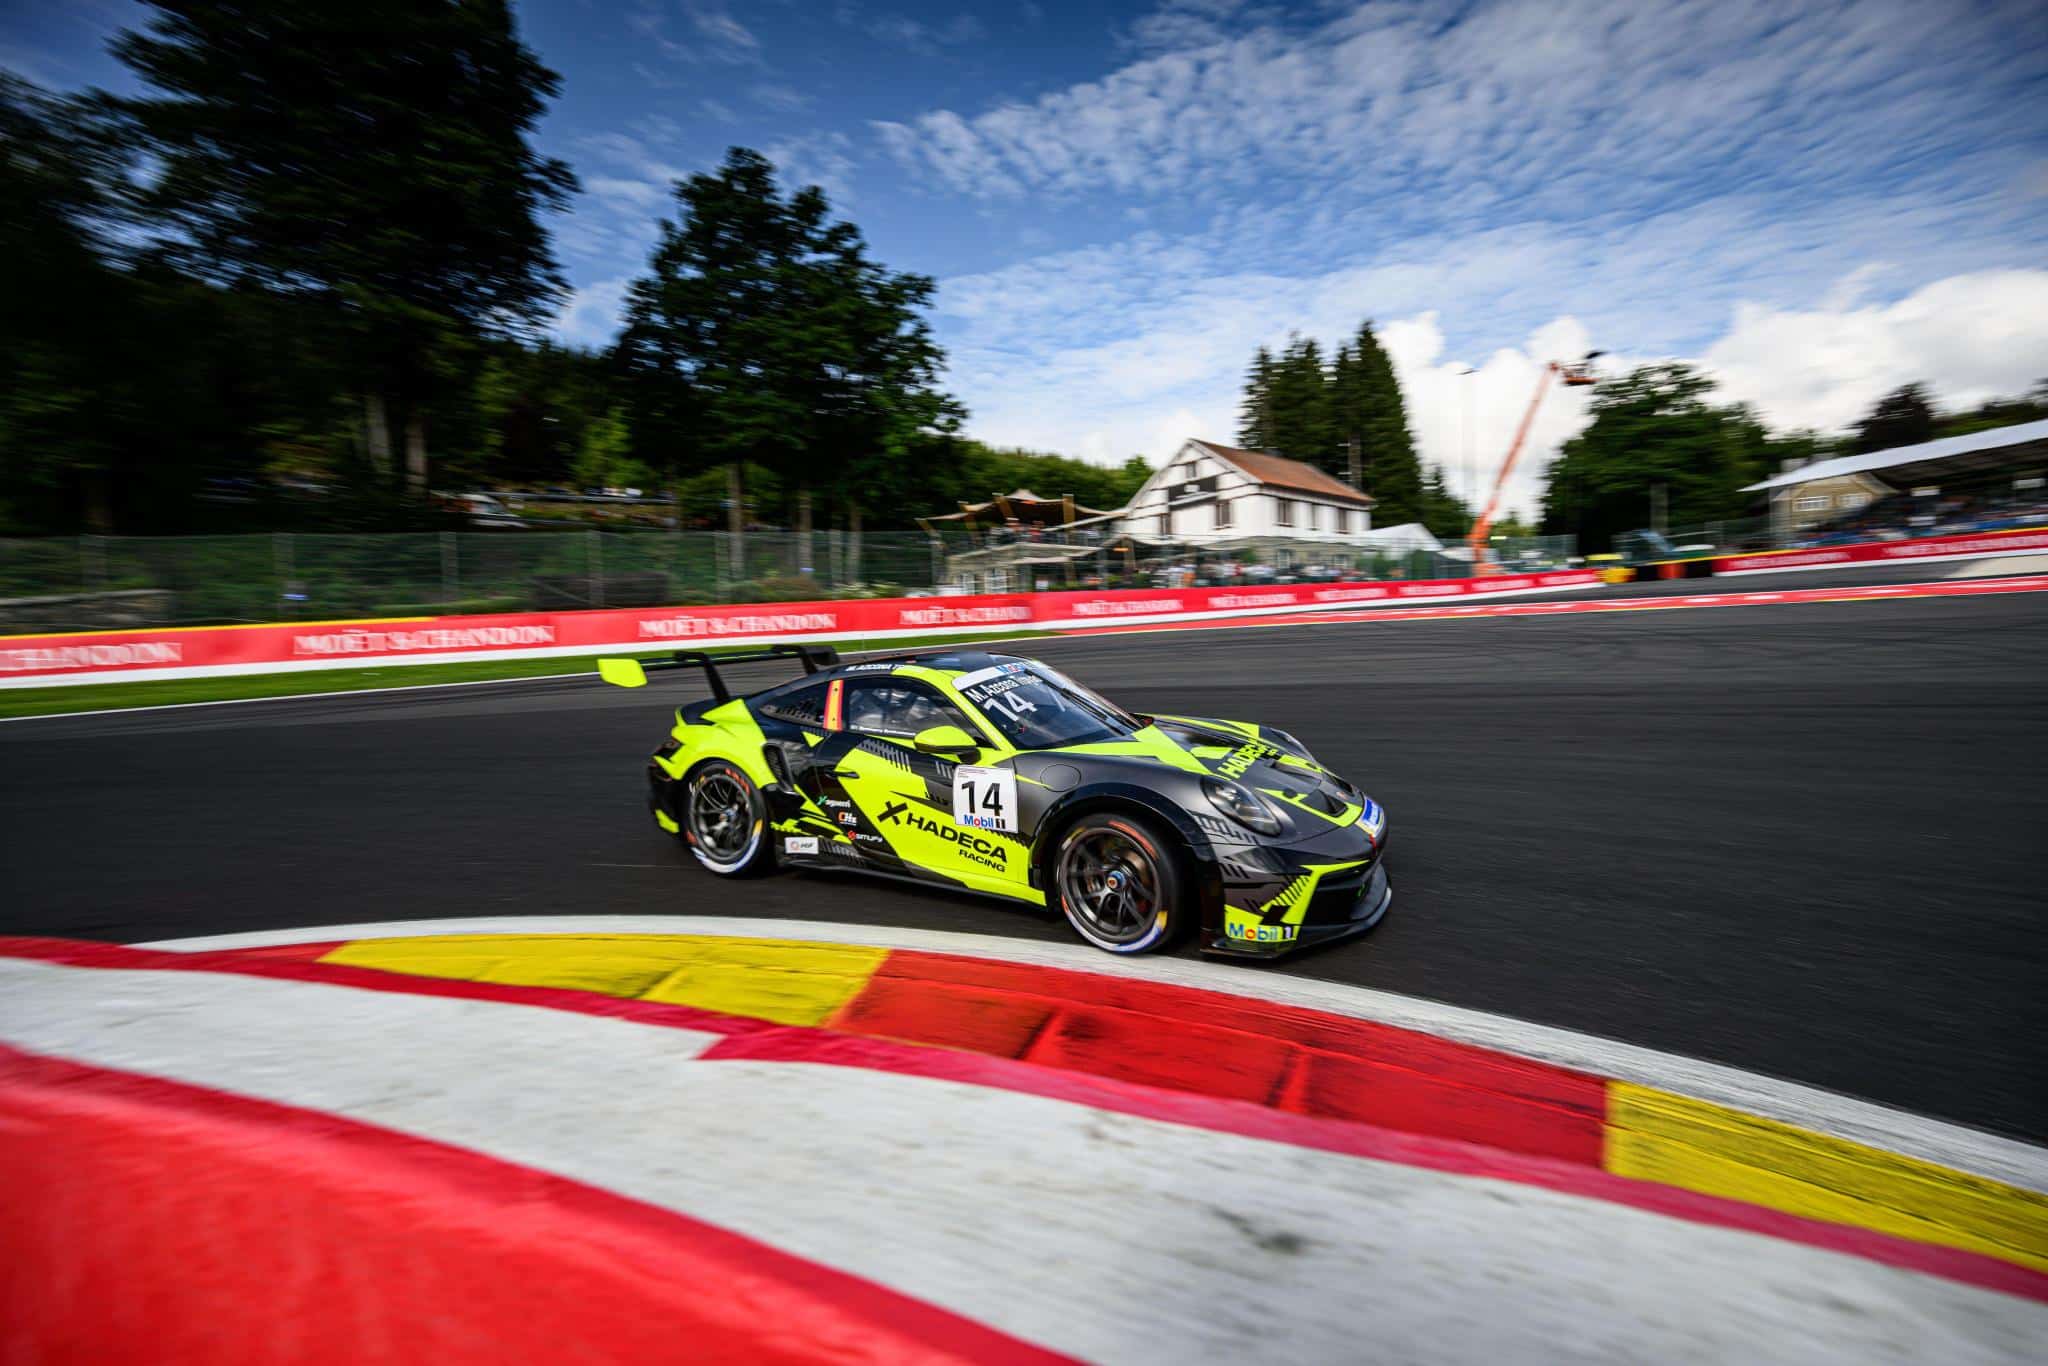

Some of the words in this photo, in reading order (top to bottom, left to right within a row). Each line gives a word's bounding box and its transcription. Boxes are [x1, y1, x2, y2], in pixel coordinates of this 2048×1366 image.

[984, 688, 1038, 721] 14
[961, 781, 1003, 816] 14
[964, 814, 994, 828] Mobil
[995, 818, 1006, 829] 1
[906, 812, 1008, 863] HADECA
[958, 850, 1006, 873] RACING
[1228, 922, 1278, 941] Mobil
[1282, 925, 1293, 940] 1
